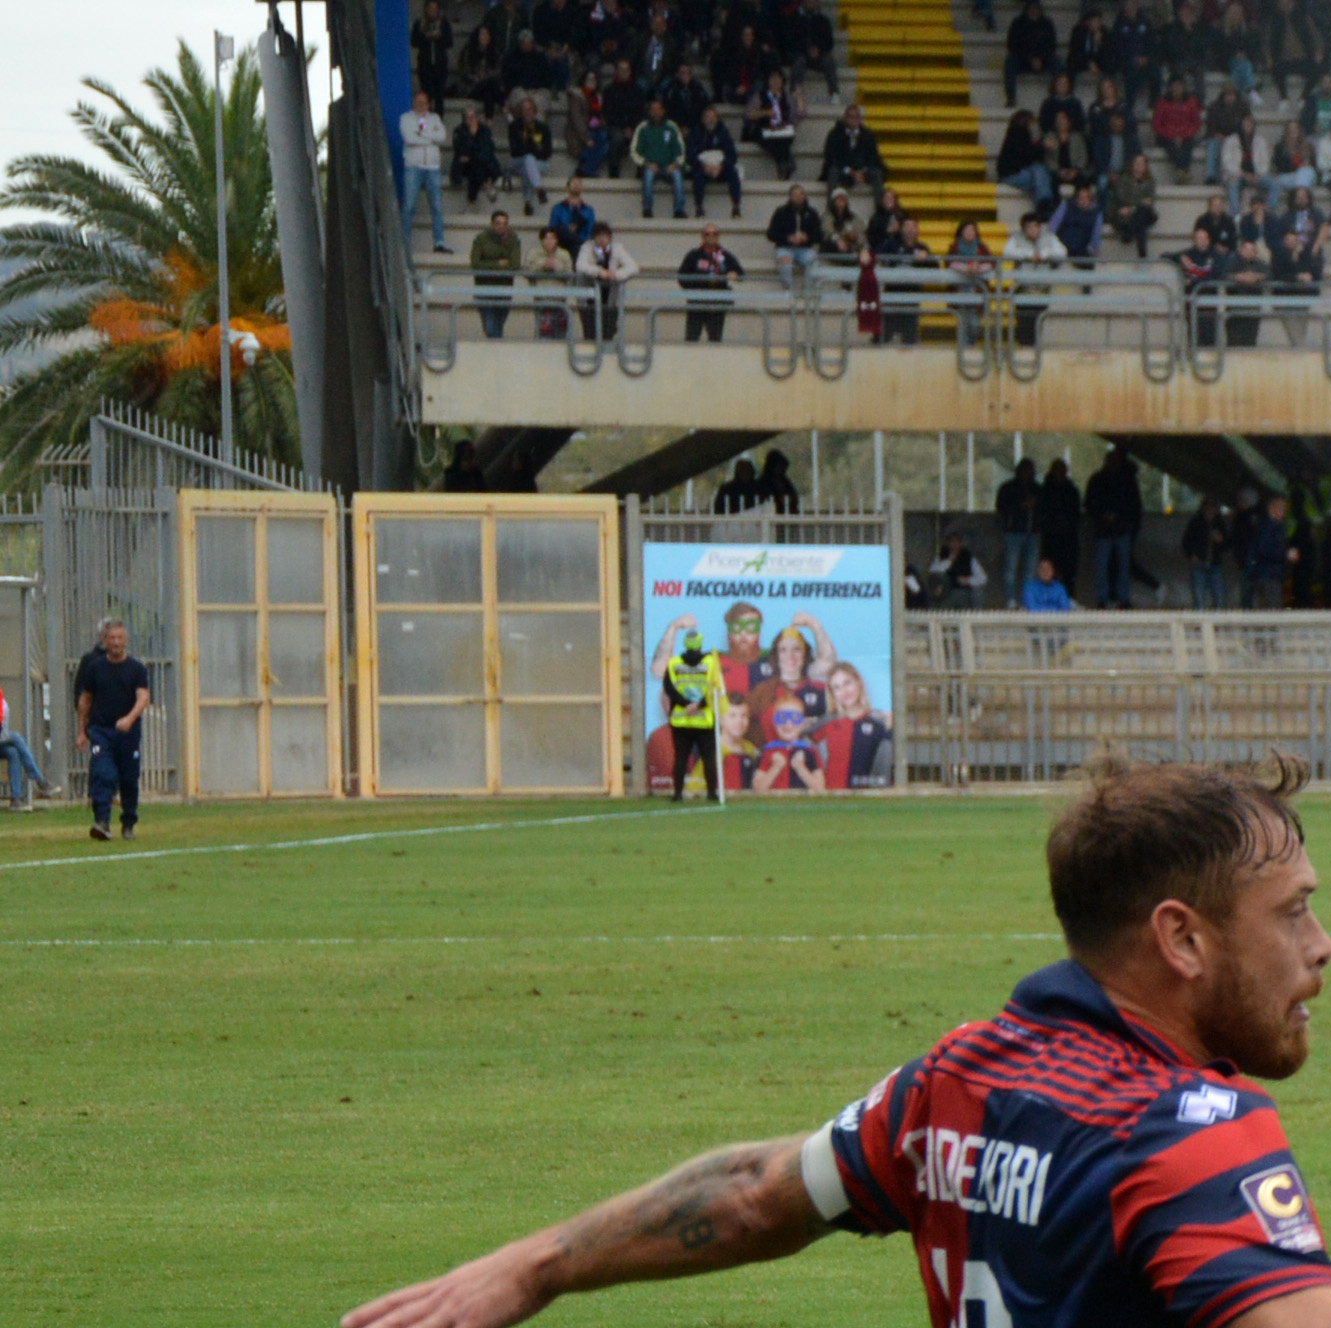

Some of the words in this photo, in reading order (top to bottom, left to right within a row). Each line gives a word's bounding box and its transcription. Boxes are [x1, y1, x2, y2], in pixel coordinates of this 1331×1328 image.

[653, 580, 683, 597] NOI
[686, 580, 764, 598] FACCIAMO
[768, 581, 788, 598] LA
[791, 581, 883, 599] DIFFERENZA
